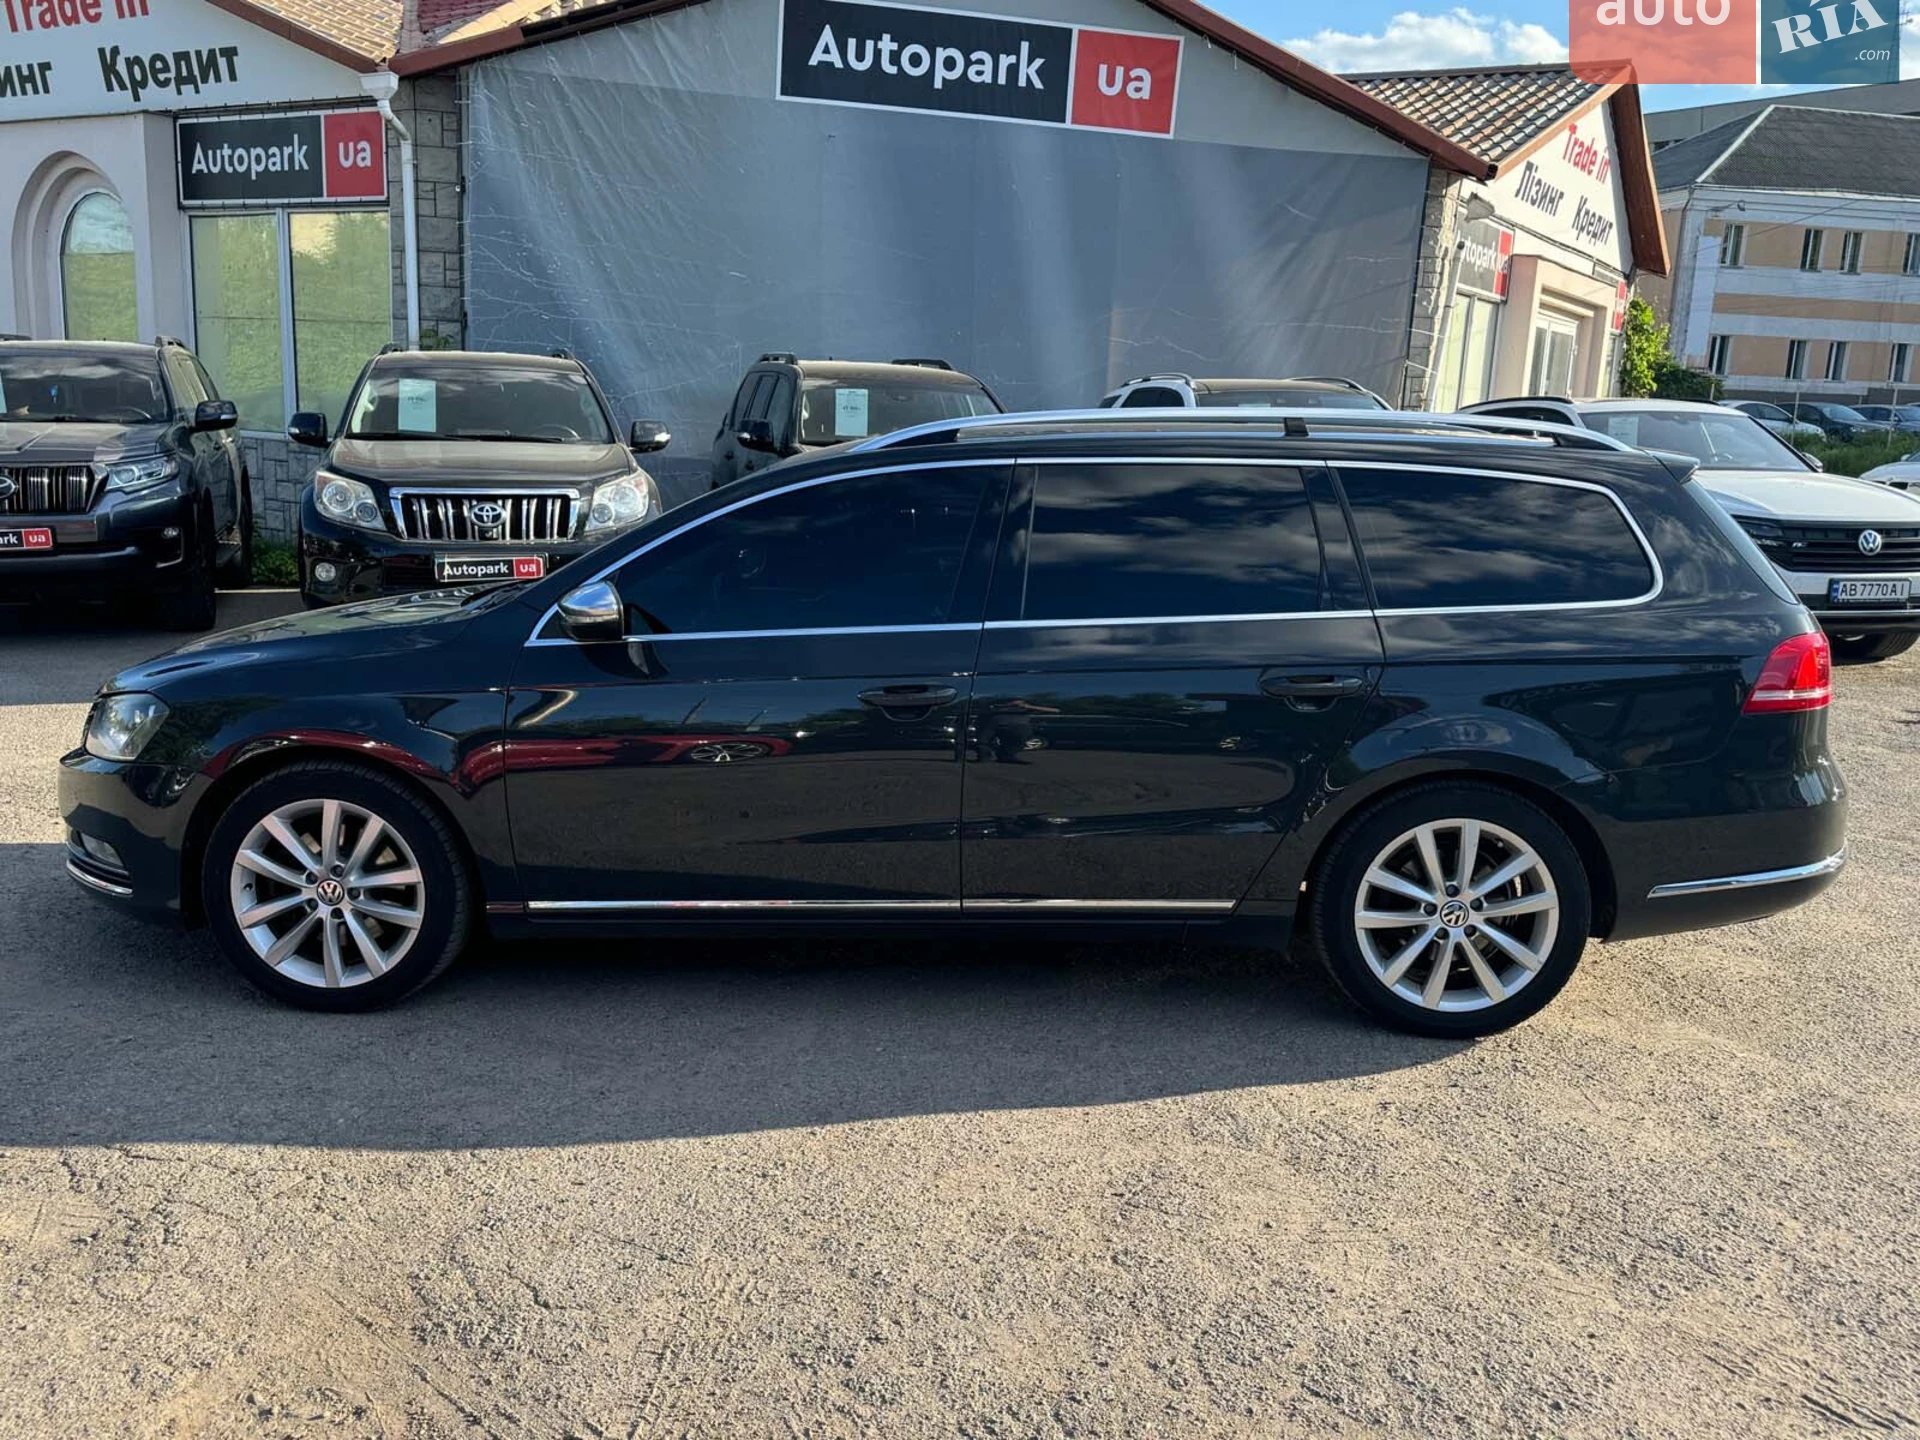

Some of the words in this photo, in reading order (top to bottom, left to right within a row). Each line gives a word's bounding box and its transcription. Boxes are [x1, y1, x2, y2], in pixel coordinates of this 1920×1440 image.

[97, 45, 239, 102] Кредит
[807, 24, 1046, 90] Autopark
[1097, 64, 1152, 100] ua
[191, 133, 309, 181] Autopark
[338, 139, 372, 169] ua
[1562, 123, 1598, 176] Trade
[1595, 145, 1611, 184] in
[1514, 160, 1564, 217] Лізинг
[1571, 194, 1613, 247] Кредит
[29, 534, 46, 544] ua
[443, 562, 509, 577] Autopark
[520, 563, 537, 573] ua
